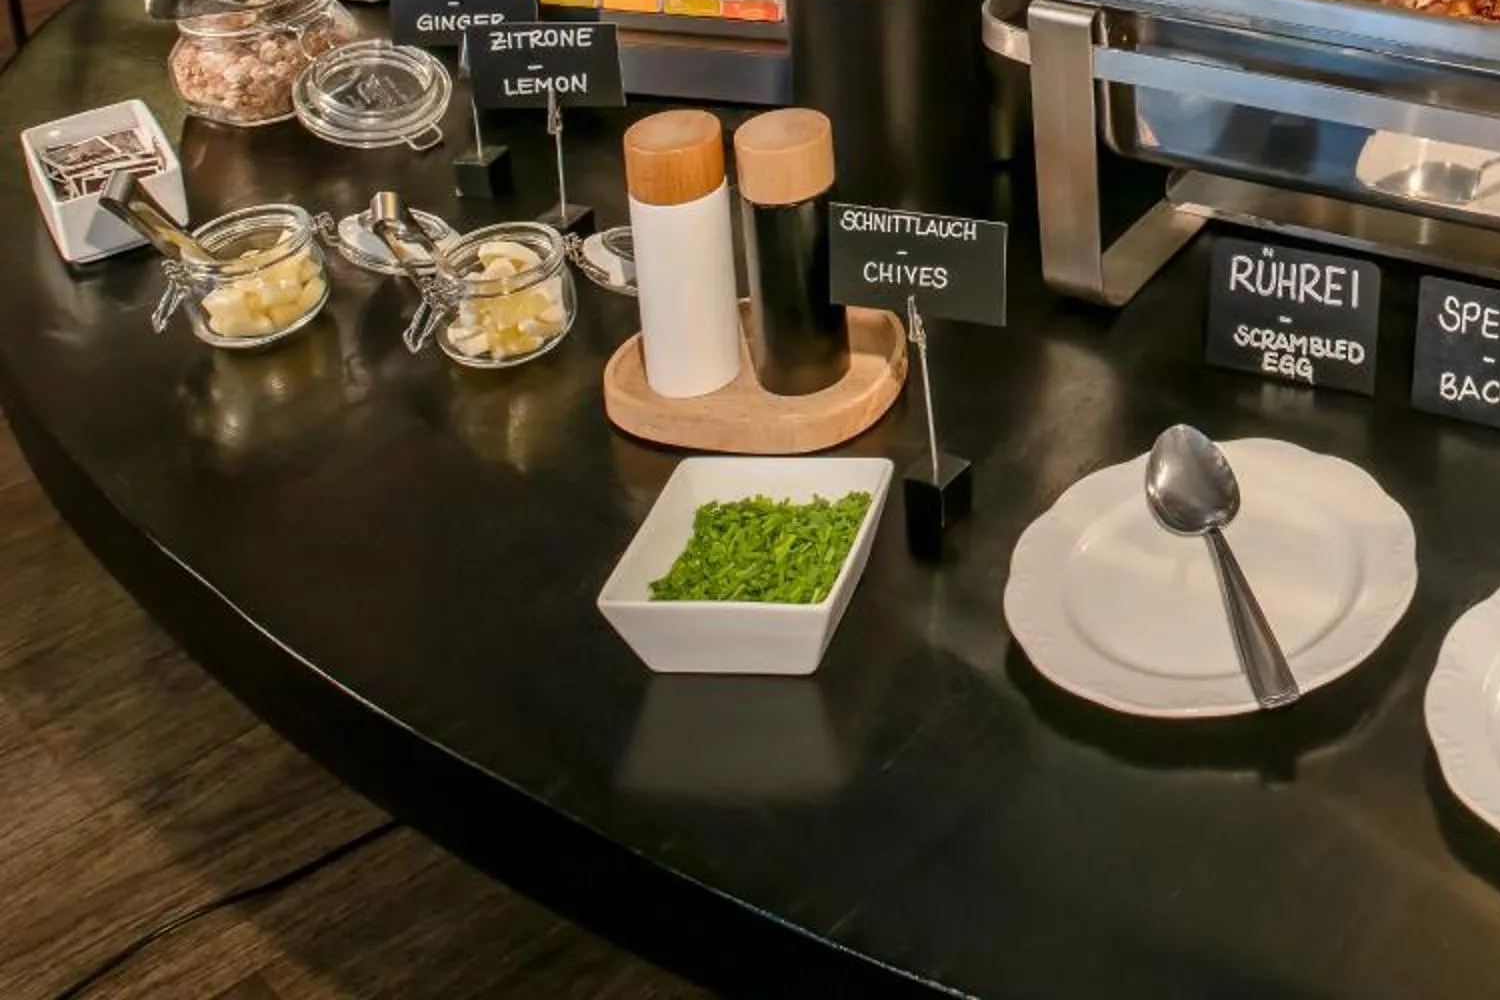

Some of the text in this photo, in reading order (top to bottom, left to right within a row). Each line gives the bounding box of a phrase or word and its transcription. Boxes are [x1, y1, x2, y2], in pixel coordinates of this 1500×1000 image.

[488, 27, 593, 51] ZITRONE
[503, 73, 588, 96] LEMON
[840, 209, 977, 241] SCHNITTLAUCH
[863, 261, 949, 289] CHIVES
[1229, 246, 1360, 310] RÜHREI
[1233, 324, 1366, 365] SCRAMBLED
[1261, 351, 1315, 385] EGG
